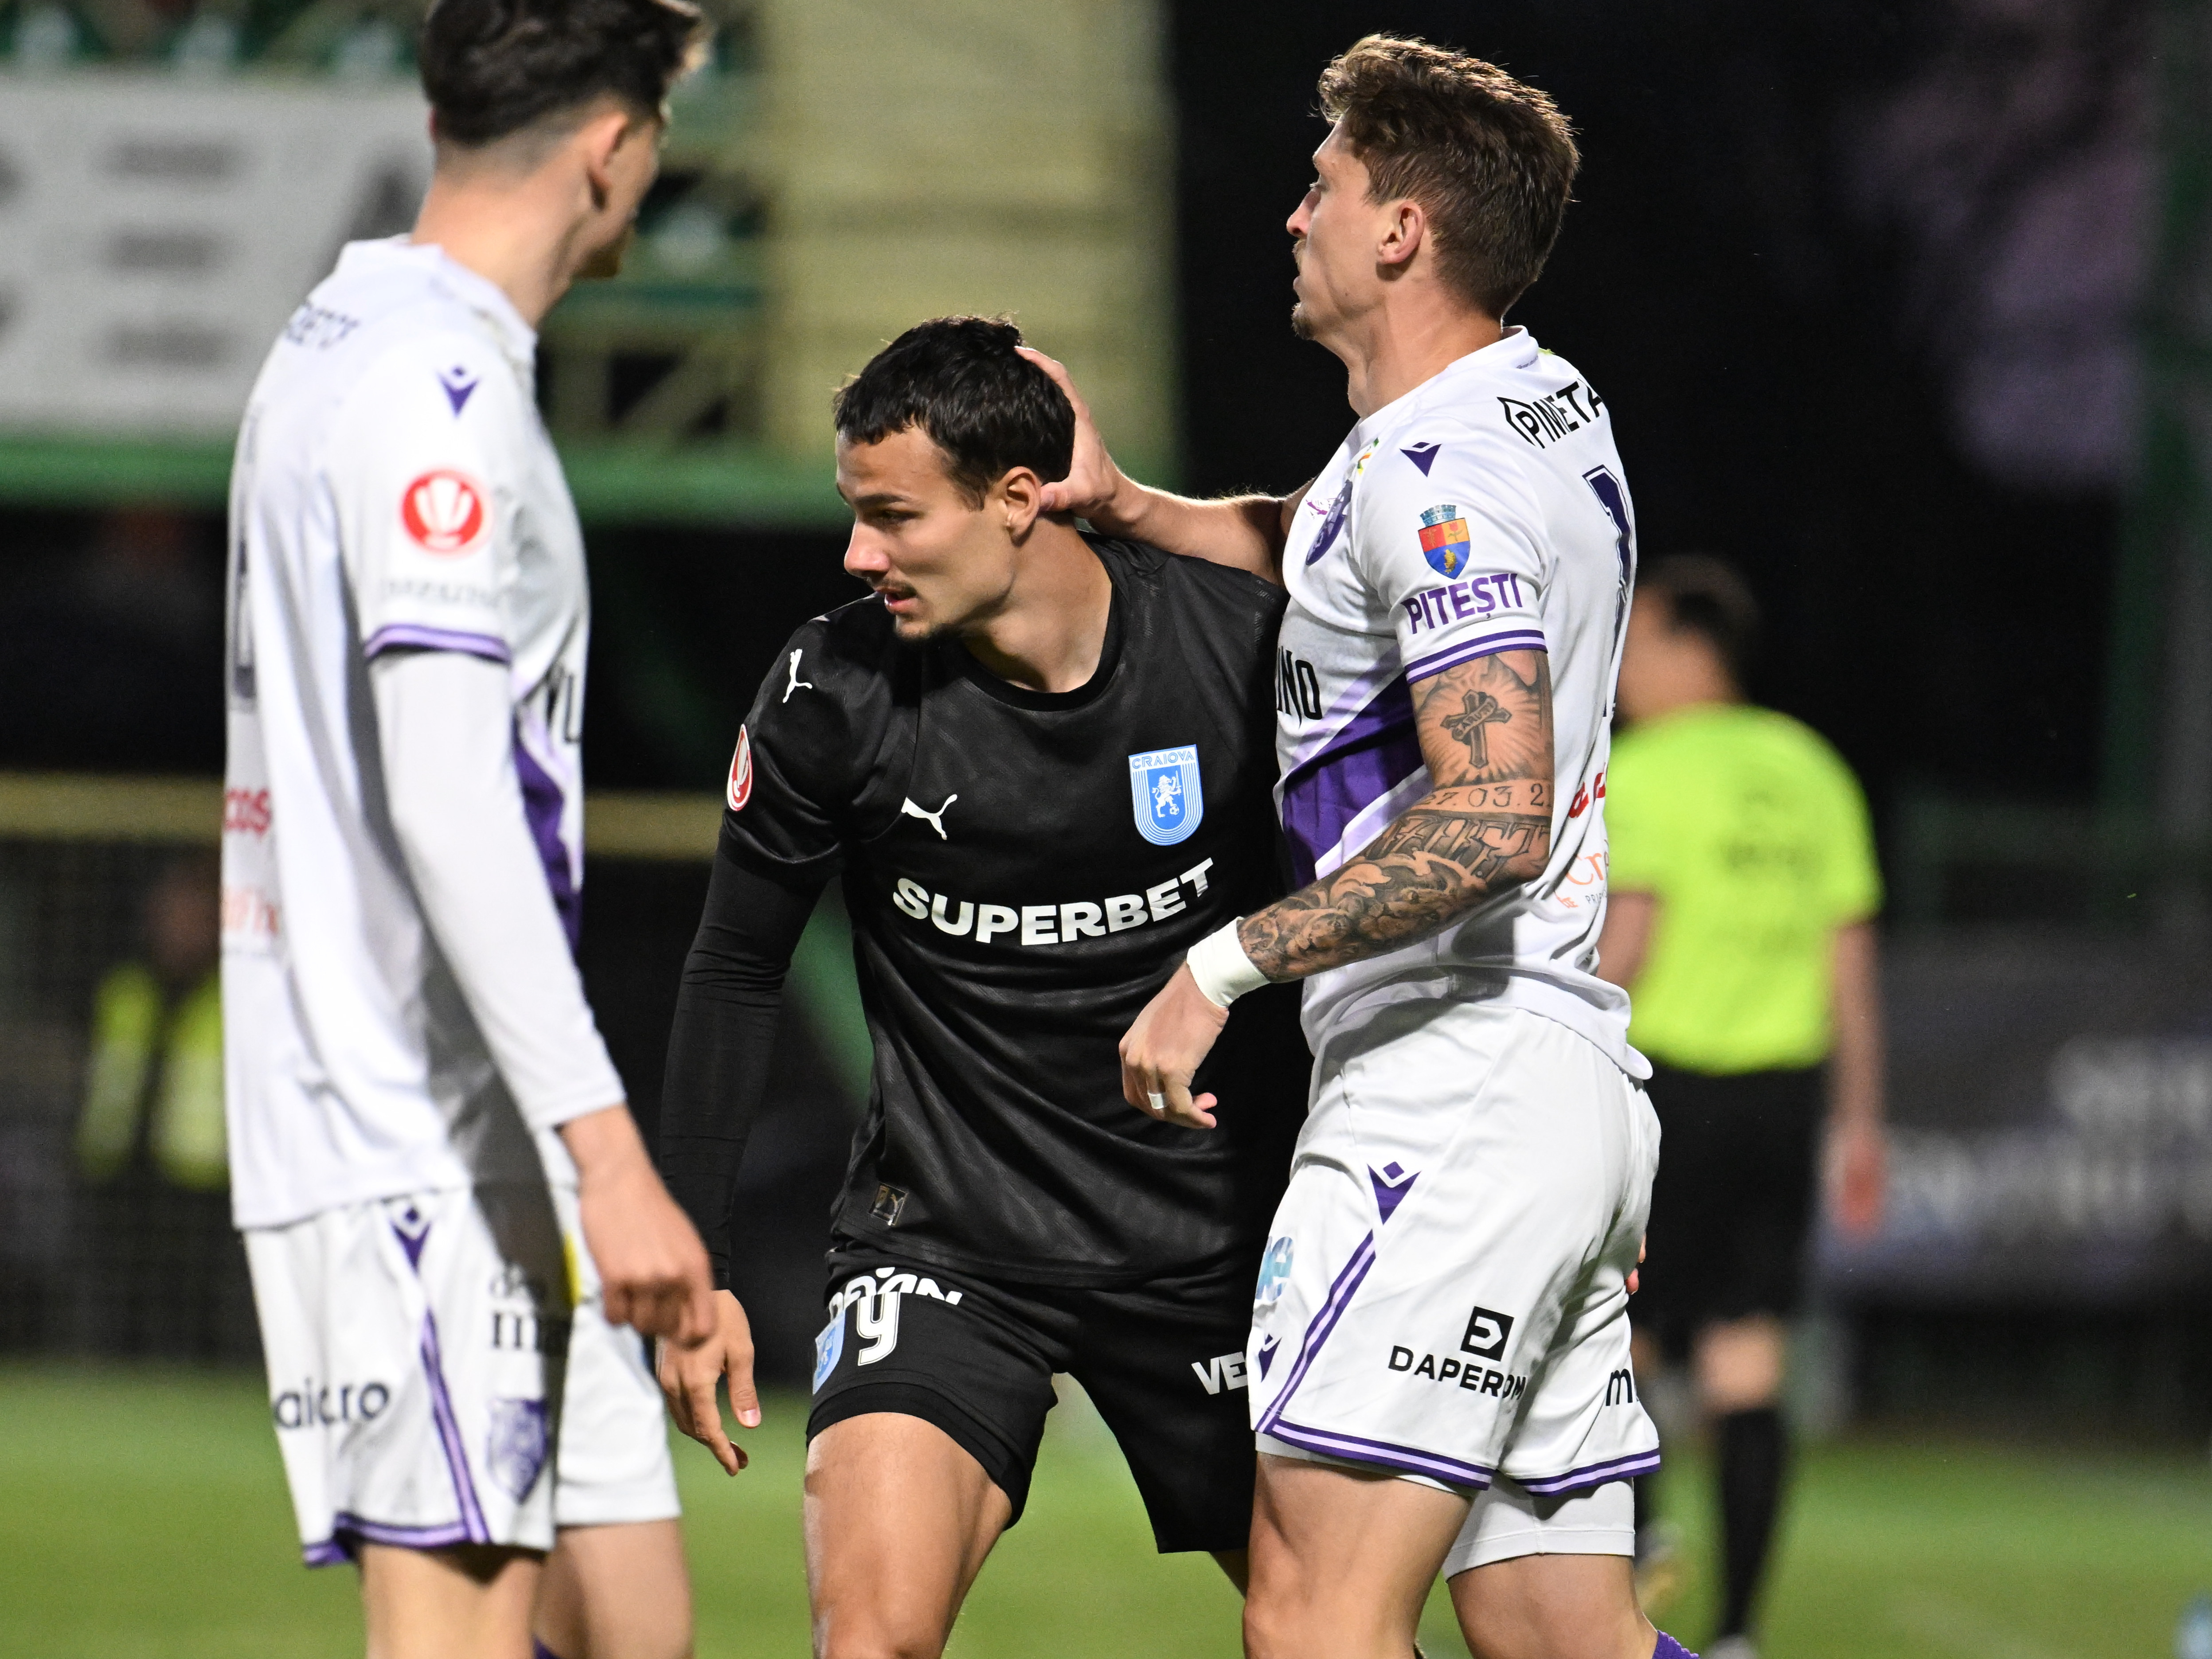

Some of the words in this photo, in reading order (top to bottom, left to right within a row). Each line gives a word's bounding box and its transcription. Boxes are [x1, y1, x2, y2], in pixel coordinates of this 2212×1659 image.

[1400, 573, 1523, 634] PITEȘTI
[1132, 751, 1194, 769] CRAIOVA
[893, 857, 1213, 945] SUPERBET
